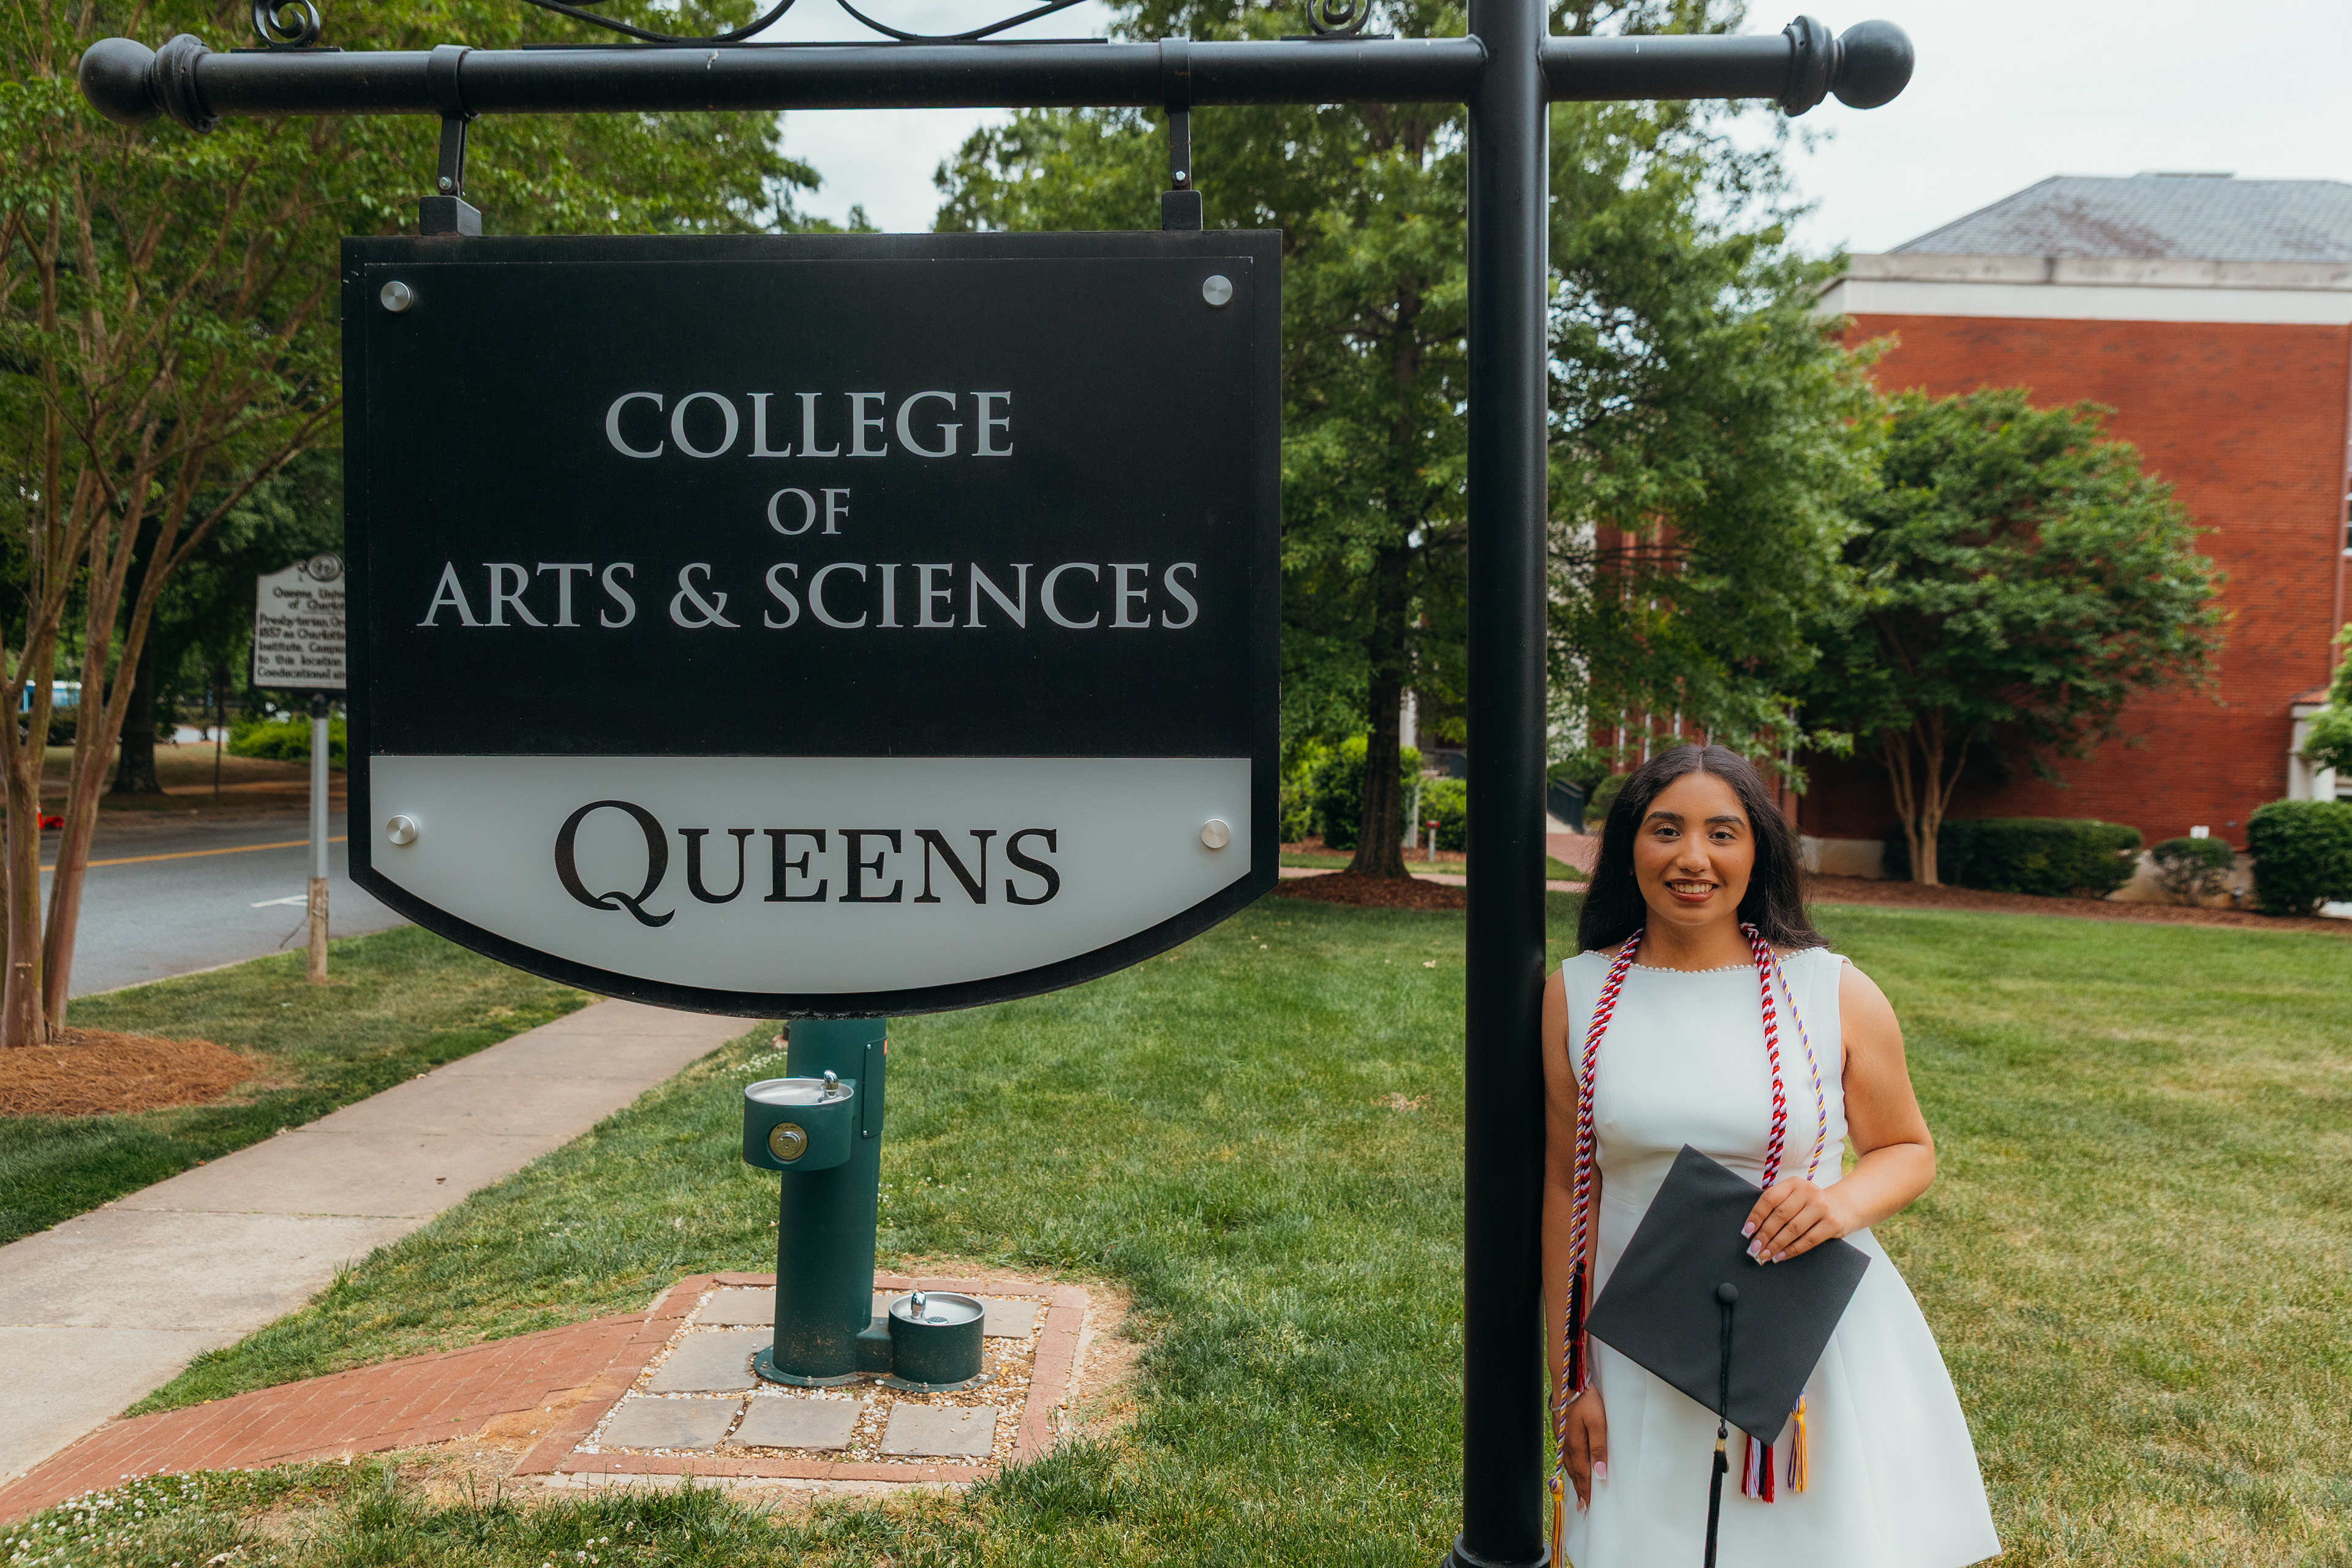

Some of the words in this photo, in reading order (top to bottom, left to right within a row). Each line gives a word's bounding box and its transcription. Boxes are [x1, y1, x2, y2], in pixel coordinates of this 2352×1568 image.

[605, 390, 1014, 458] COLLEGE
[767, 487, 851, 536] OF
[273, 586, 312, 598] Queens
[288, 598, 300, 609] of
[417, 560, 636, 630] ARTS
[669, 562, 741, 629] &
[764, 561, 1199, 630] SCIENCES
[258, 654, 270, 663] to
[275, 654, 295, 665] this
[300, 654, 342, 666] location
[258, 666, 331, 678] Coeducational
[554, 799, 1061, 928] QUEENS
